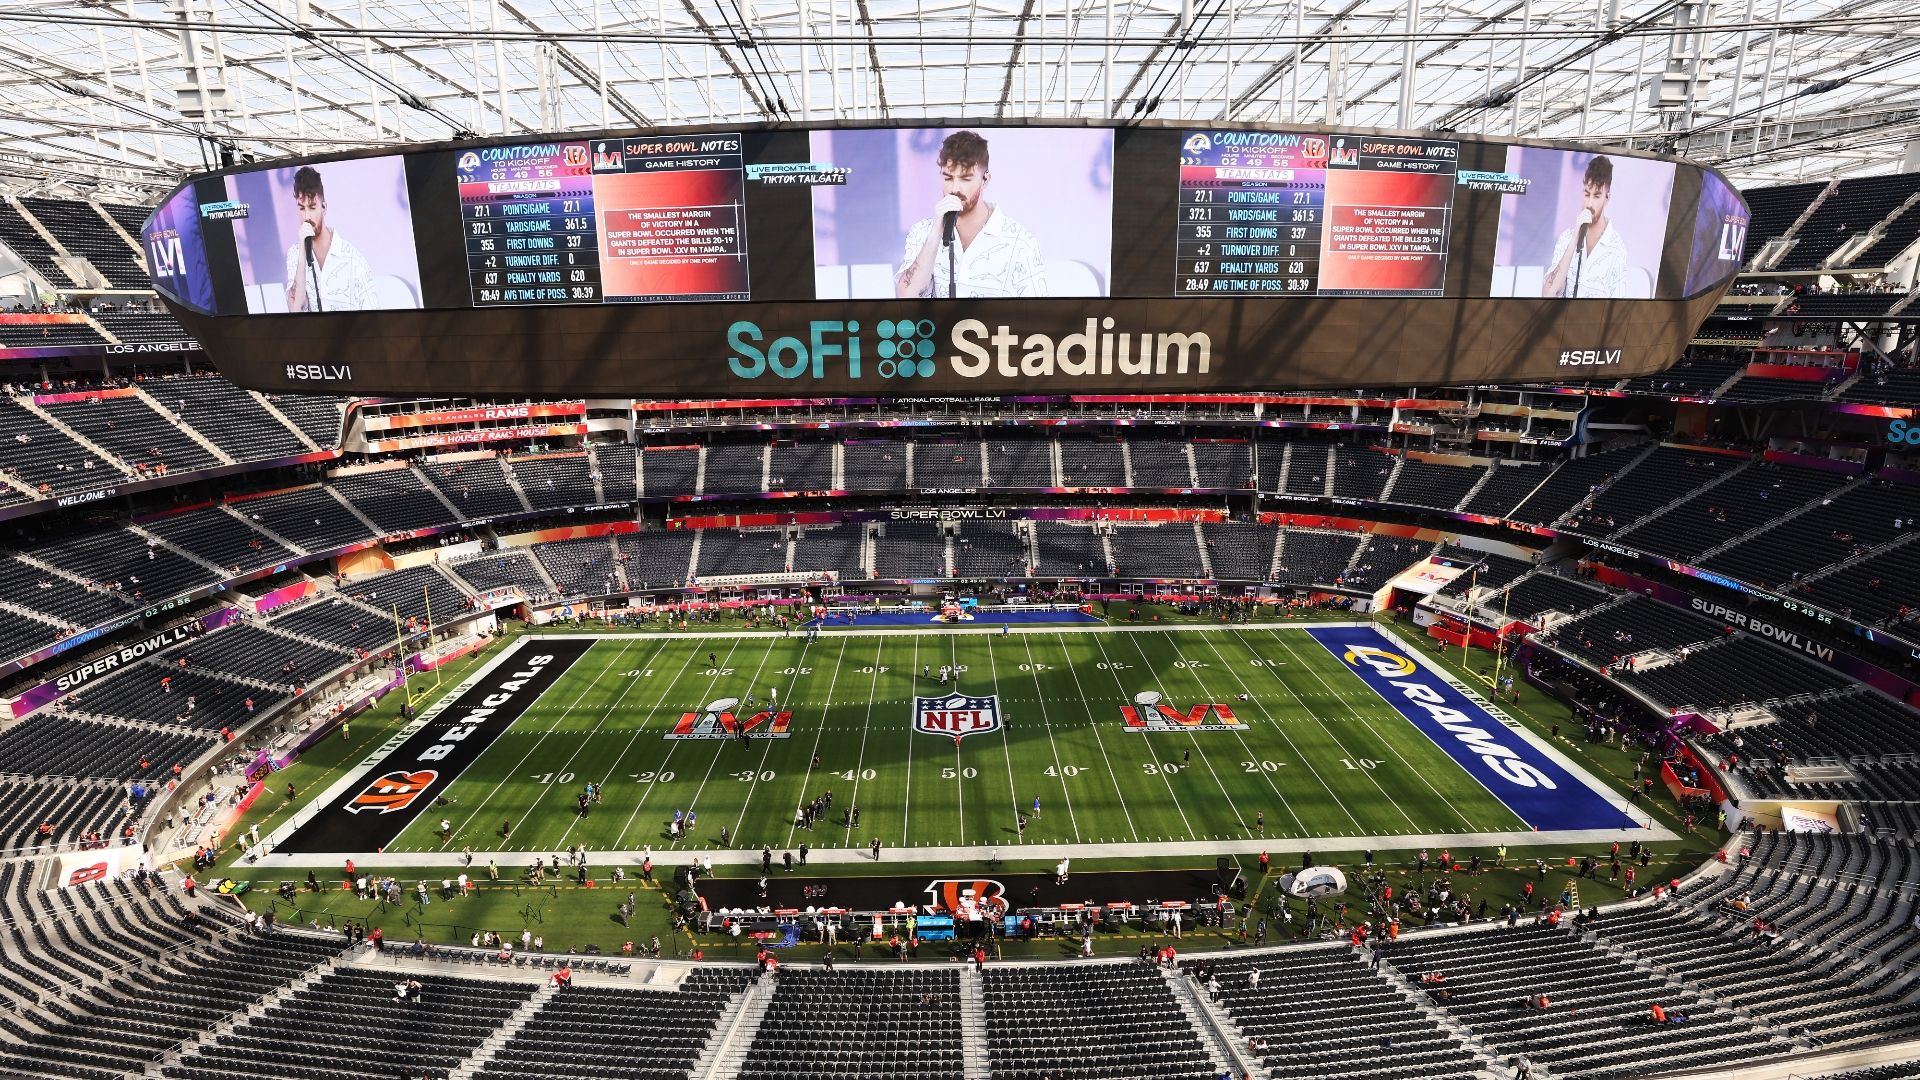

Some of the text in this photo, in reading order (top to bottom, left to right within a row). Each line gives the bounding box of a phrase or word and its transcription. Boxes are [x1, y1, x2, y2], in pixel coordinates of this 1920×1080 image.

[1213, 133, 1300, 147] COUNTDOWN
[482, 145, 560, 161] COUNTDOWN
[626, 140, 738, 155] SUPER BOWL NOTES
[1362, 143, 1455, 157] SUPER BOWL NOTES
[508, 158, 550, 167] KICKOFF
[677, 159, 720, 167] HISTORY
[762, 174, 844, 184] TIKTOK TAILGATE
[1468, 182, 1525, 192] TIKTOK TAILGATE
[1195, 191, 1310, 204] 27.1 POINTS/GAME 27.1
[1190, 208, 1314, 221] 372.1 YARDS/GAME 361.5
[1196, 226, 1306, 239] 355 FIRST DOWNS 337
[1198, 244, 1295, 256] +2 TURNOVER DIFF. 0
[151, 238, 186, 277] LVI
[1195, 262, 1303, 273] 637 PENALTY YARDS 620
[1186, 279, 1309, 290] 28:49 AVG TIME OF POSS. 30:39
[105, 345, 134, 354] LOS
[727, 316, 1211, 379] SoFi Stadium
[1560, 350, 1621, 365] #SBLVI
[287, 365, 352, 380] #SBLVI
[486, 408, 528, 418] RAMS
[411, 428, 549, 446] WHOSE HOUSE? RAMS HOUSE!
[1888, 419, 1920, 444] So
[58, 490, 106, 507] WELCOME
[891, 510, 1006, 519] SUPER BOWL LVI
[1582, 538, 1640, 559] LOS ANGELES
[1695, 570, 1740, 590] COUNTDOWN
[1748, 588, 1780, 602] KICKOFF
[1784, 602, 1798, 611] 02
[1801, 608, 1814, 616] 49
[52, 630, 100, 655] COUNTDOWN
[146, 608, 158, 618] 02
[162, 602, 174, 611] 49
[1692, 598, 1834, 662] SUPER BOWL LVI
[56, 654, 119, 691] SUPER
[120, 632, 172, 662] BOWL
[417, 654, 554, 762] BENGALS
[1448, 680, 1522, 728] END RACISM
[924, 710, 991, 731] NFL
[1120, 703, 1242, 727] LVI
[362, 684, 473, 766] IT TAKES ALL OF US
[1388, 680, 1558, 790] RAMS
[1142, 762, 1179, 774] 30
[1240, 760, 1278, 772] 20
[1338, 758, 1376, 770] 10
[538, 772, 575, 784] 10
[637, 772, 674, 783] 20
[739, 770, 776, 782] 30
[841, 768, 876, 780] 40
[942, 767, 978, 779] 50
[1044, 766, 1078, 777] 40
